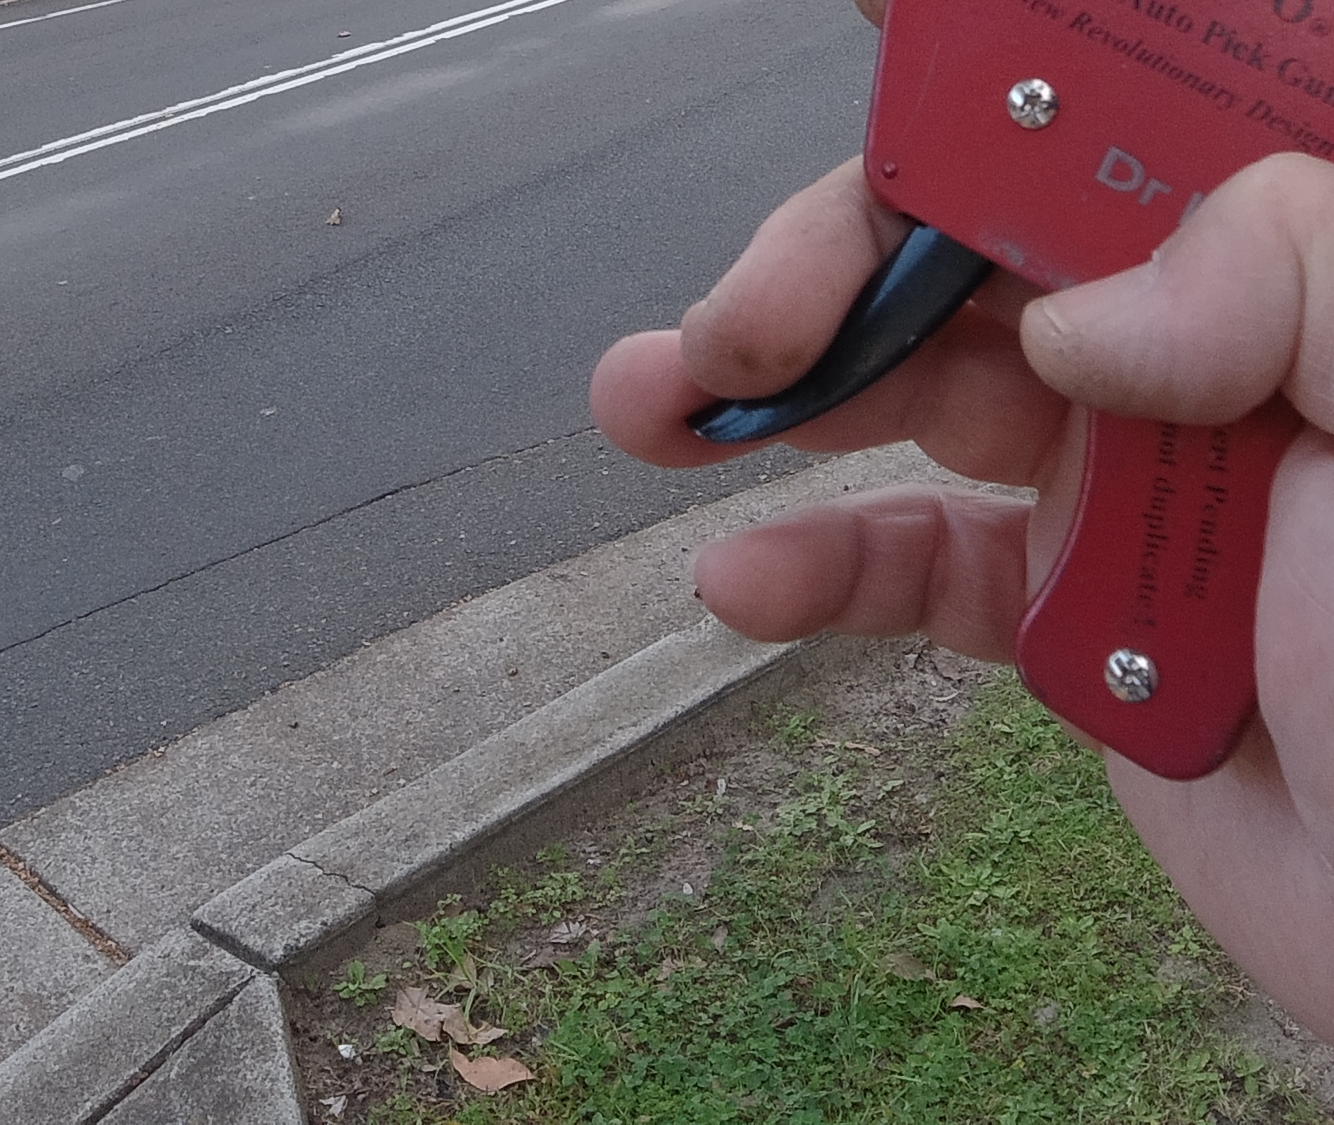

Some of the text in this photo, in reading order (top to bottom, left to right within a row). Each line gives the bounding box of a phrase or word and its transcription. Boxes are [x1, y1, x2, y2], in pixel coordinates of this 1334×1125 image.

[1068, 10, 1243, 111] Revolutionary
[1201, 19, 1271, 71] Pick
[1095, 145, 1172, 206] Dr
